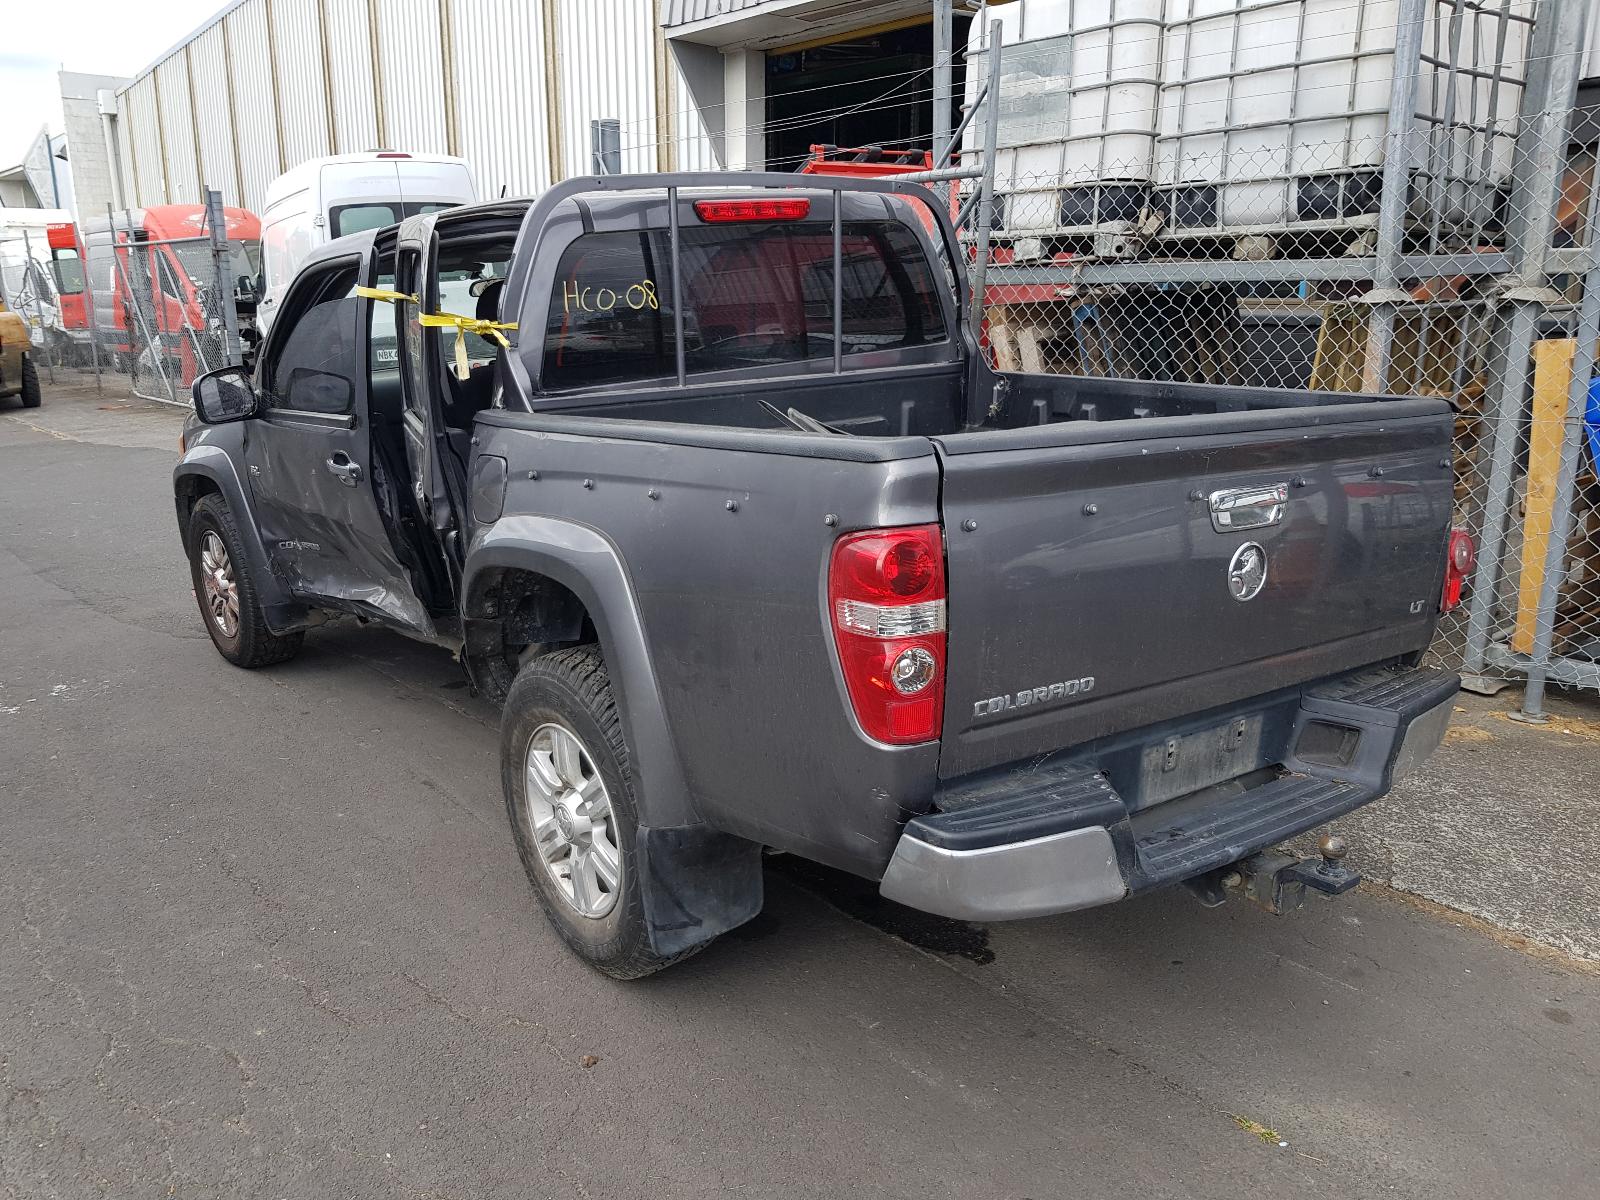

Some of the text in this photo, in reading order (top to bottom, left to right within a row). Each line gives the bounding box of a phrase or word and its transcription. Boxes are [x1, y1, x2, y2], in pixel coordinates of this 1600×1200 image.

[563, 279, 659, 313] HCO-08
[1409, 599, 1425, 614] LT
[973, 676, 1096, 717] COLORADO
